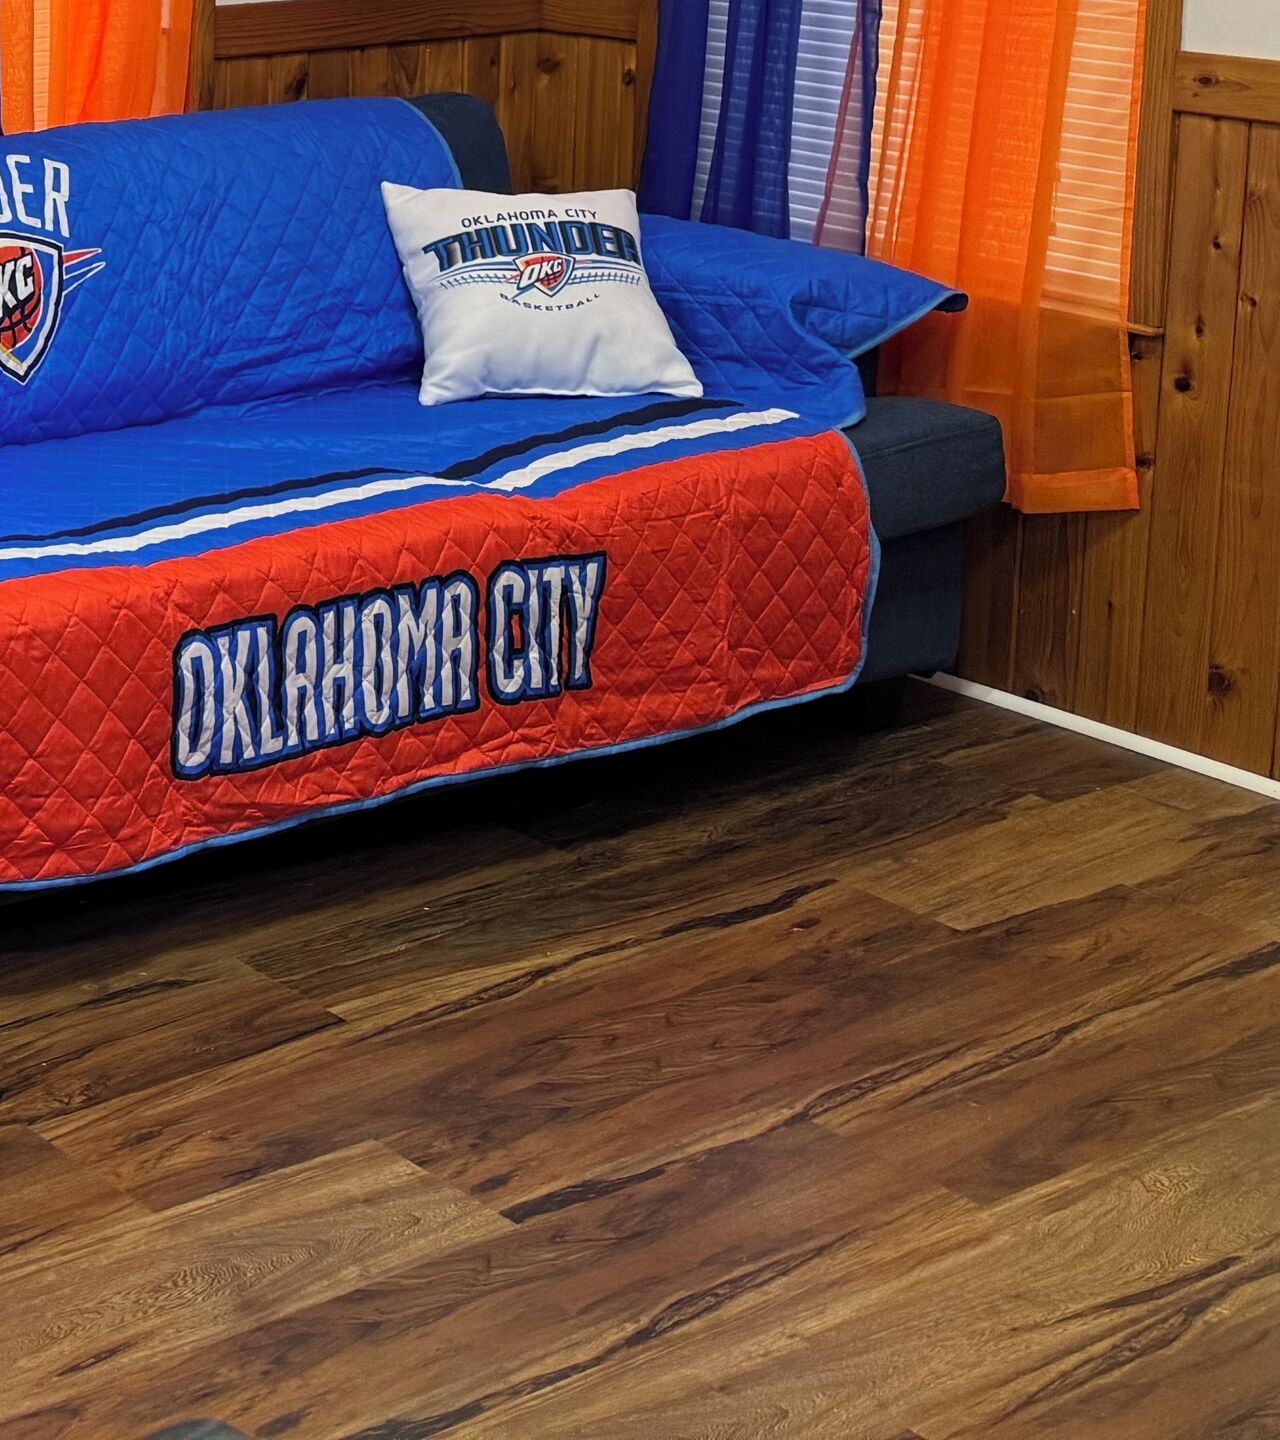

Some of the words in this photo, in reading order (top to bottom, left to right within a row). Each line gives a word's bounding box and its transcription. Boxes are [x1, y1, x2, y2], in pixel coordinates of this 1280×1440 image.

[461, 208, 558, 229] OKLAHOMA
[565, 208, 598, 220] CITY
[421, 220, 640, 273] THUNDER
[523, 259, 562, 286] OKC
[500, 292, 601, 312] BASKETBALL
[172, 570, 480, 781] OKLAHOMA
[486, 550, 608, 704] CITY
